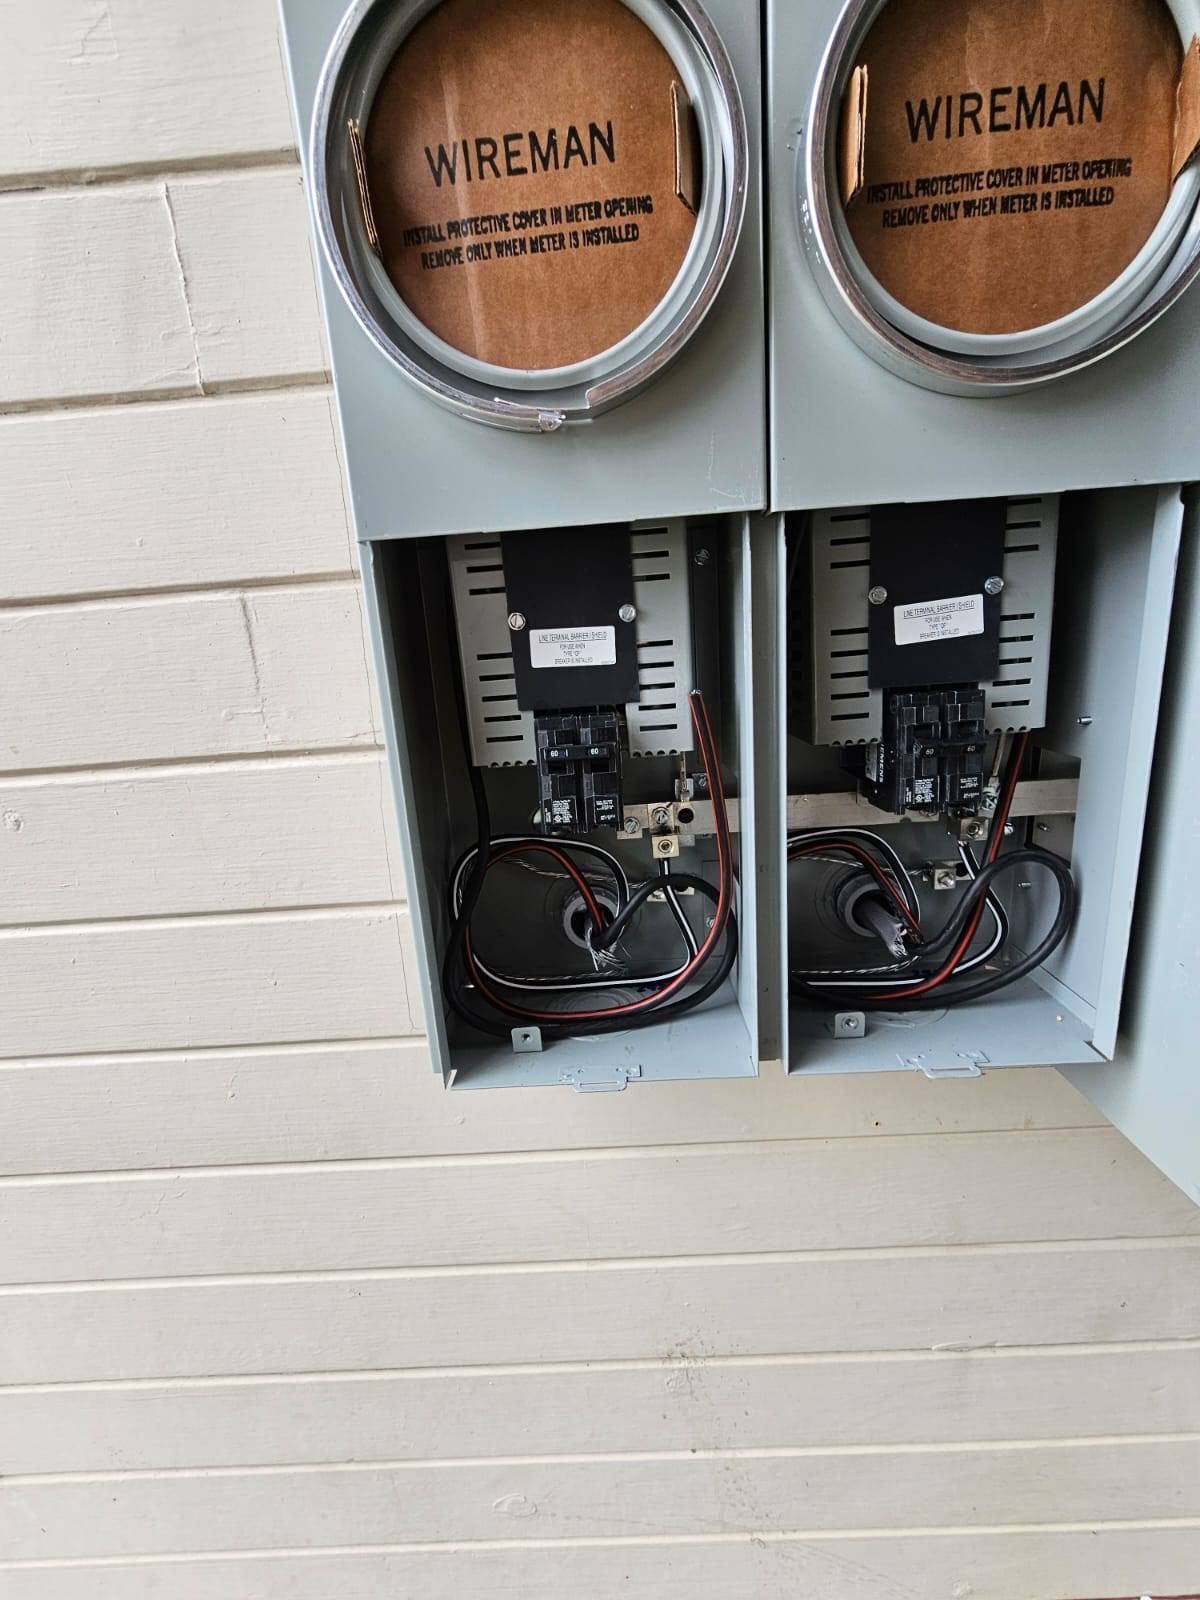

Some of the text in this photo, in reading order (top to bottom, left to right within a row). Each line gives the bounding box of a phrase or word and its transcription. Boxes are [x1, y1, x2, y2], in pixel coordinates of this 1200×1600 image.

[905, 78, 1105, 143] WIREMAN
[424, 120, 616, 187] WIREMAN
[867, 157, 1132, 204] INSTALL PROTECTIVE COVER IN METER OPENING
[403, 194, 654, 248] INSTALL PROTECTIVE COVER IN METER OPENING
[882, 186, 1114, 228] REMOVE ONLY WHEN METER IS INSTALLED
[420, 223, 640, 270] REMOVE ONLY WHEN METER IS INSTALLED
